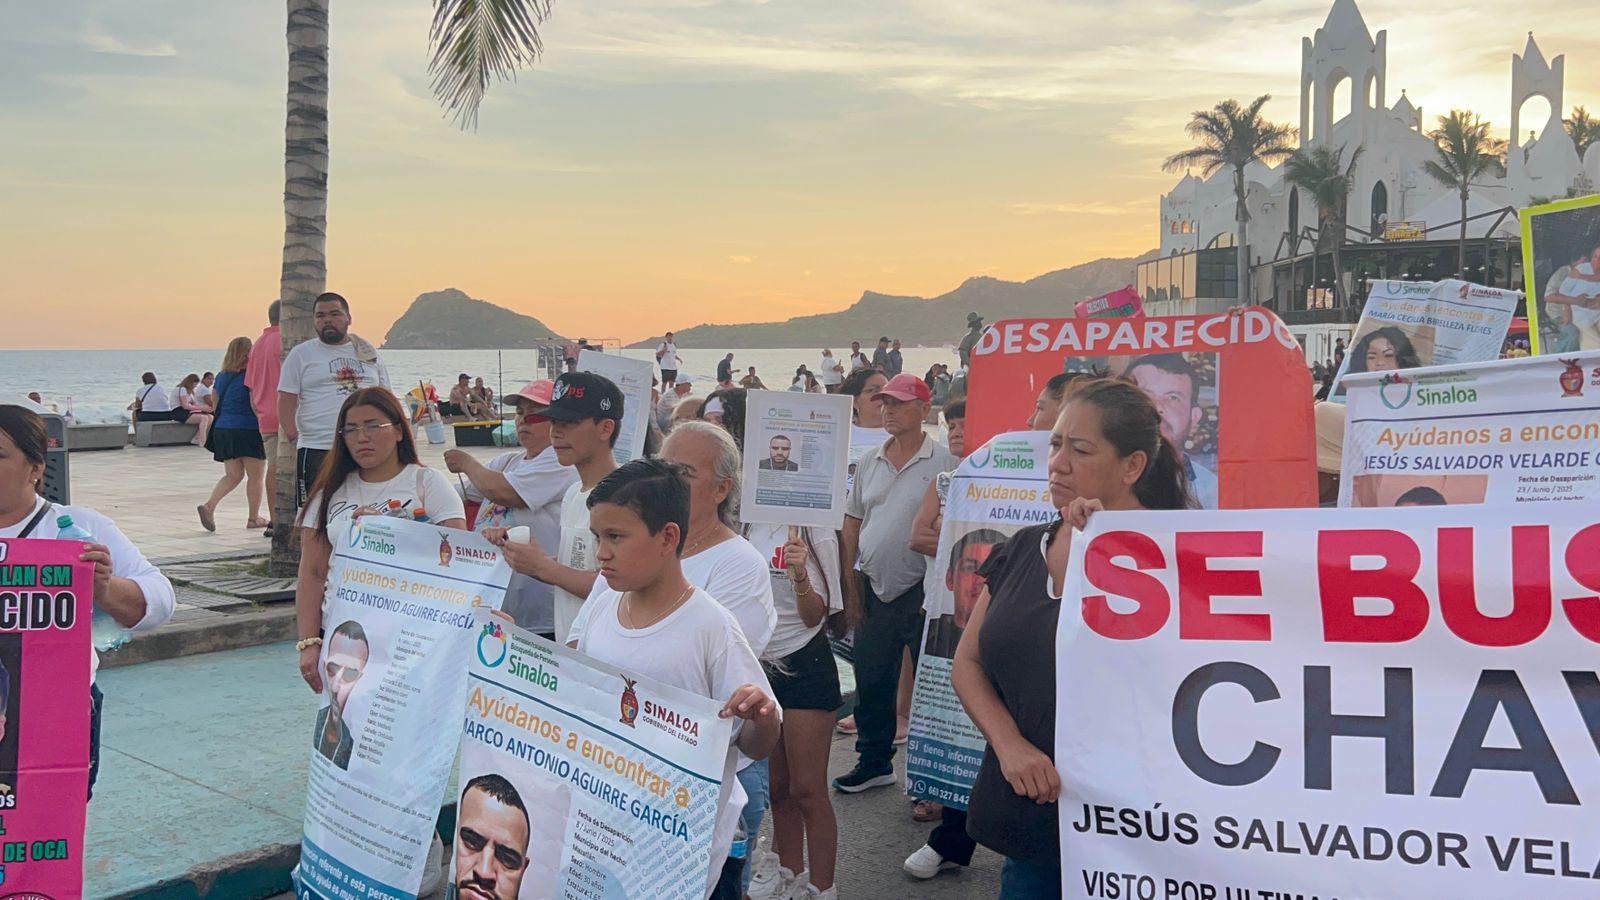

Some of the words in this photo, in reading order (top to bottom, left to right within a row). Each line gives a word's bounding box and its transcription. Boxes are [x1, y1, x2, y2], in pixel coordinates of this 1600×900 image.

[1416, 385, 1477, 406] Sinaloa
[1376, 426, 1490, 451] Ayúdanos
[1499, 427, 1512, 443] a
[992, 454, 1034, 470] Sinaloa
[1364, 452, 1408, 471] JESÚS
[1413, 455, 1503, 471] SALVADOR
[1510, 451, 1590, 469] VELARDE
[966, 482, 1037, 503] Ayúdanos
[1041, 490, 1051, 503] a
[989, 505, 1022, 520] ADÁN
[1023, 509, 1061, 523] ANAY
[360, 535, 396, 556] Sinaloa
[455, 545, 497, 561] SINALOA
[0, 565, 37, 587] LAN
[41, 565, 72, 587] SM
[1081, 529, 1272, 642] SE
[336, 587, 358, 603] ARCO
[359, 592, 400, 612] ANTONIO
[400, 603, 438, 623] AGUIRRE
[400, 579, 408, 593] a
[471, 594, 483, 608] a
[0, 590, 76, 631] CIDO
[507, 654, 559, 692] Sinaloa
[642, 715, 667, 732] GOBIERNO
[667, 725, 677, 736] DEL
[677, 731, 698, 747] ESTADO
[643, 700, 698, 738] SINALOA
[468, 687, 562, 743] Ayúdanos
[566, 731, 579, 751] a
[582, 738, 672, 799] encontrar
[675, 786, 690, 808] a
[0, 794, 15, 808] OS
[505, 737, 570, 778] ANTONIO
[571, 767, 628, 812] AGUIRRE
[630, 799, 689, 842] GARCÍA
[939, 789, 953, 800] 327
[577, 809, 593, 823] Fecha
[3, 842, 27, 862] DE
[31, 839, 68, 861] OCA
[574, 832, 599, 853] Municipio
[1073, 803, 1199, 845] JESÚS
[1213, 816, 1472, 869] SALVADOR
[1485, 835, 1600, 881] VEL
[318, 858, 343, 880] referente
[350, 877, 366, 893] esta
[1082, 870, 1156, 900] VISTO
